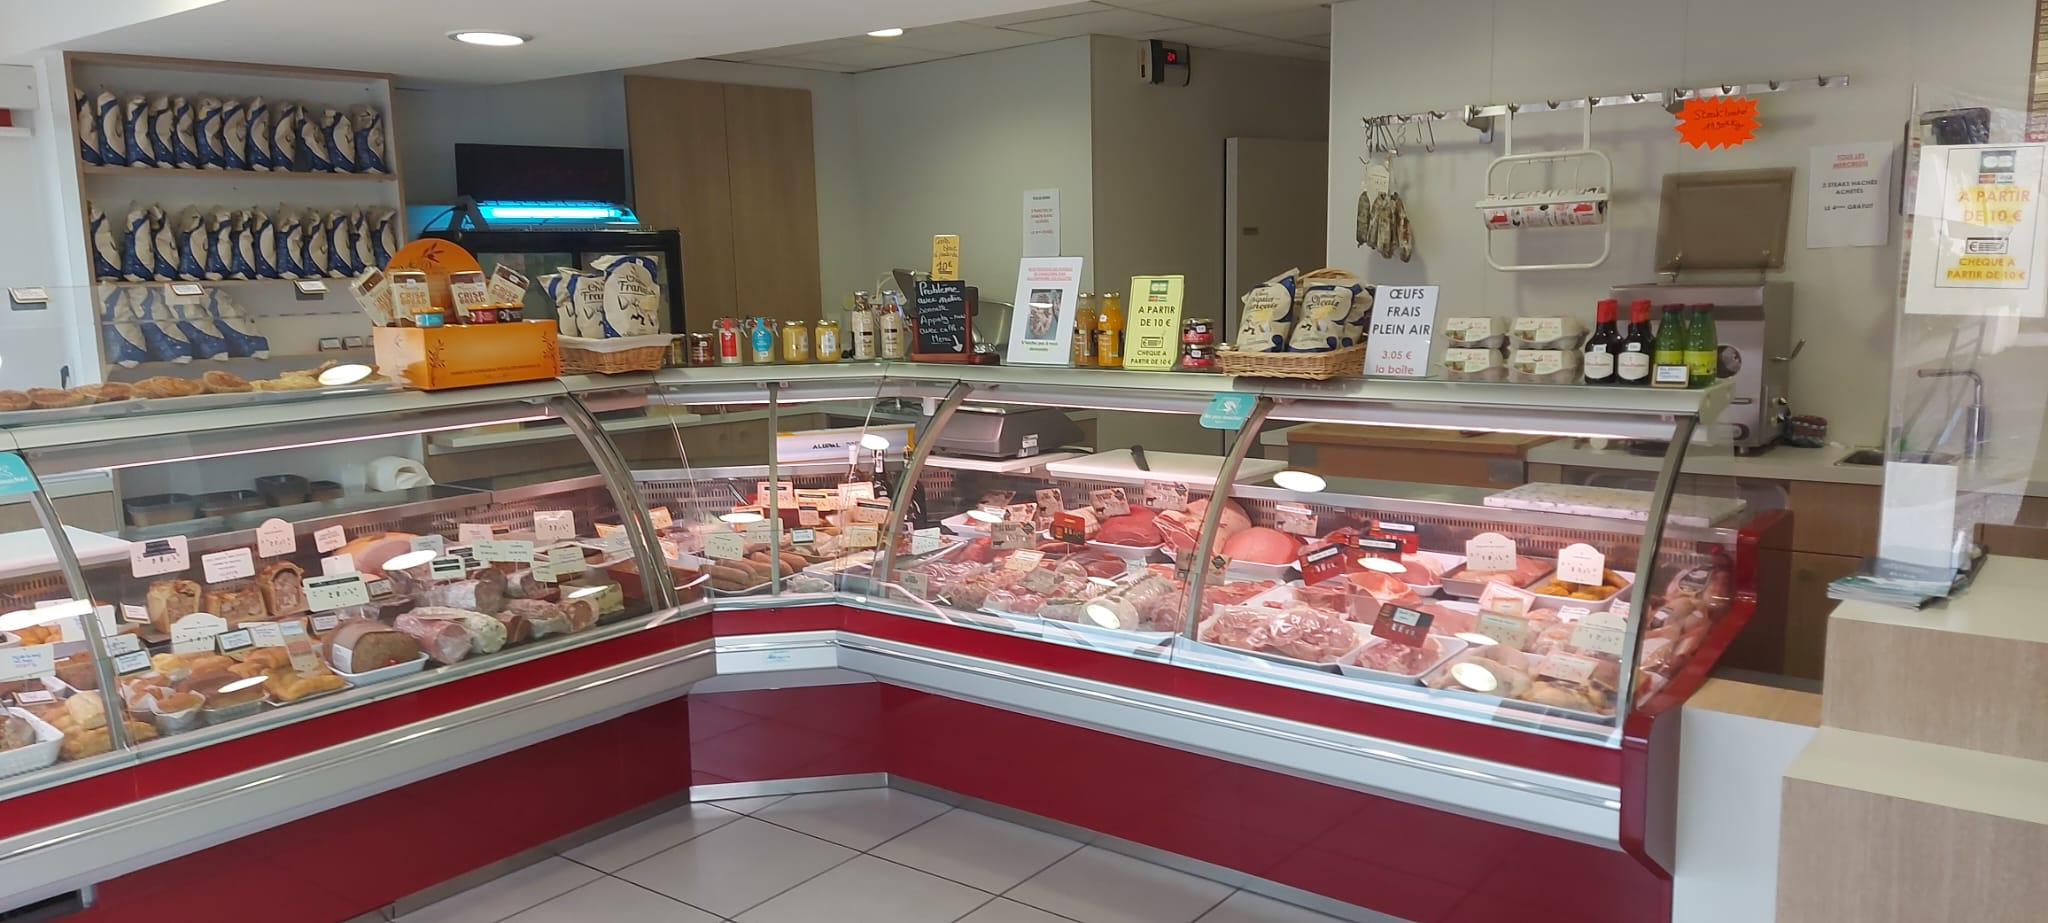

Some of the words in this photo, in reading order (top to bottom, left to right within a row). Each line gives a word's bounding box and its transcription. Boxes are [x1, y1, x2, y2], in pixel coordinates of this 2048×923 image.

[1976, 190, 2031, 202] PARTIR
[1964, 210, 1984, 221] DE
[1991, 210, 2008, 221] 10
[2013, 210, 2023, 221] €
[1946, 270, 1983, 279] PARTIR
[1986, 270, 2000, 279] DE
[1389, 288, 1424, 299] ŒUFS
[1148, 306, 1176, 314] PARTIR
[1387, 306, 1421, 317] FRAIS
[1140, 318, 1152, 327] DE
[1154, 318, 1164, 327] 10
[1165, 319, 1172, 327] €
[1373, 324, 1405, 334] PLEIN
[1409, 324, 1430, 335] AIR
[1382, 350, 1403, 359] 3.05
[1405, 351, 1412, 360] €
[1376, 364, 1385, 374] la
[1388, 365, 1414, 375] boîte
